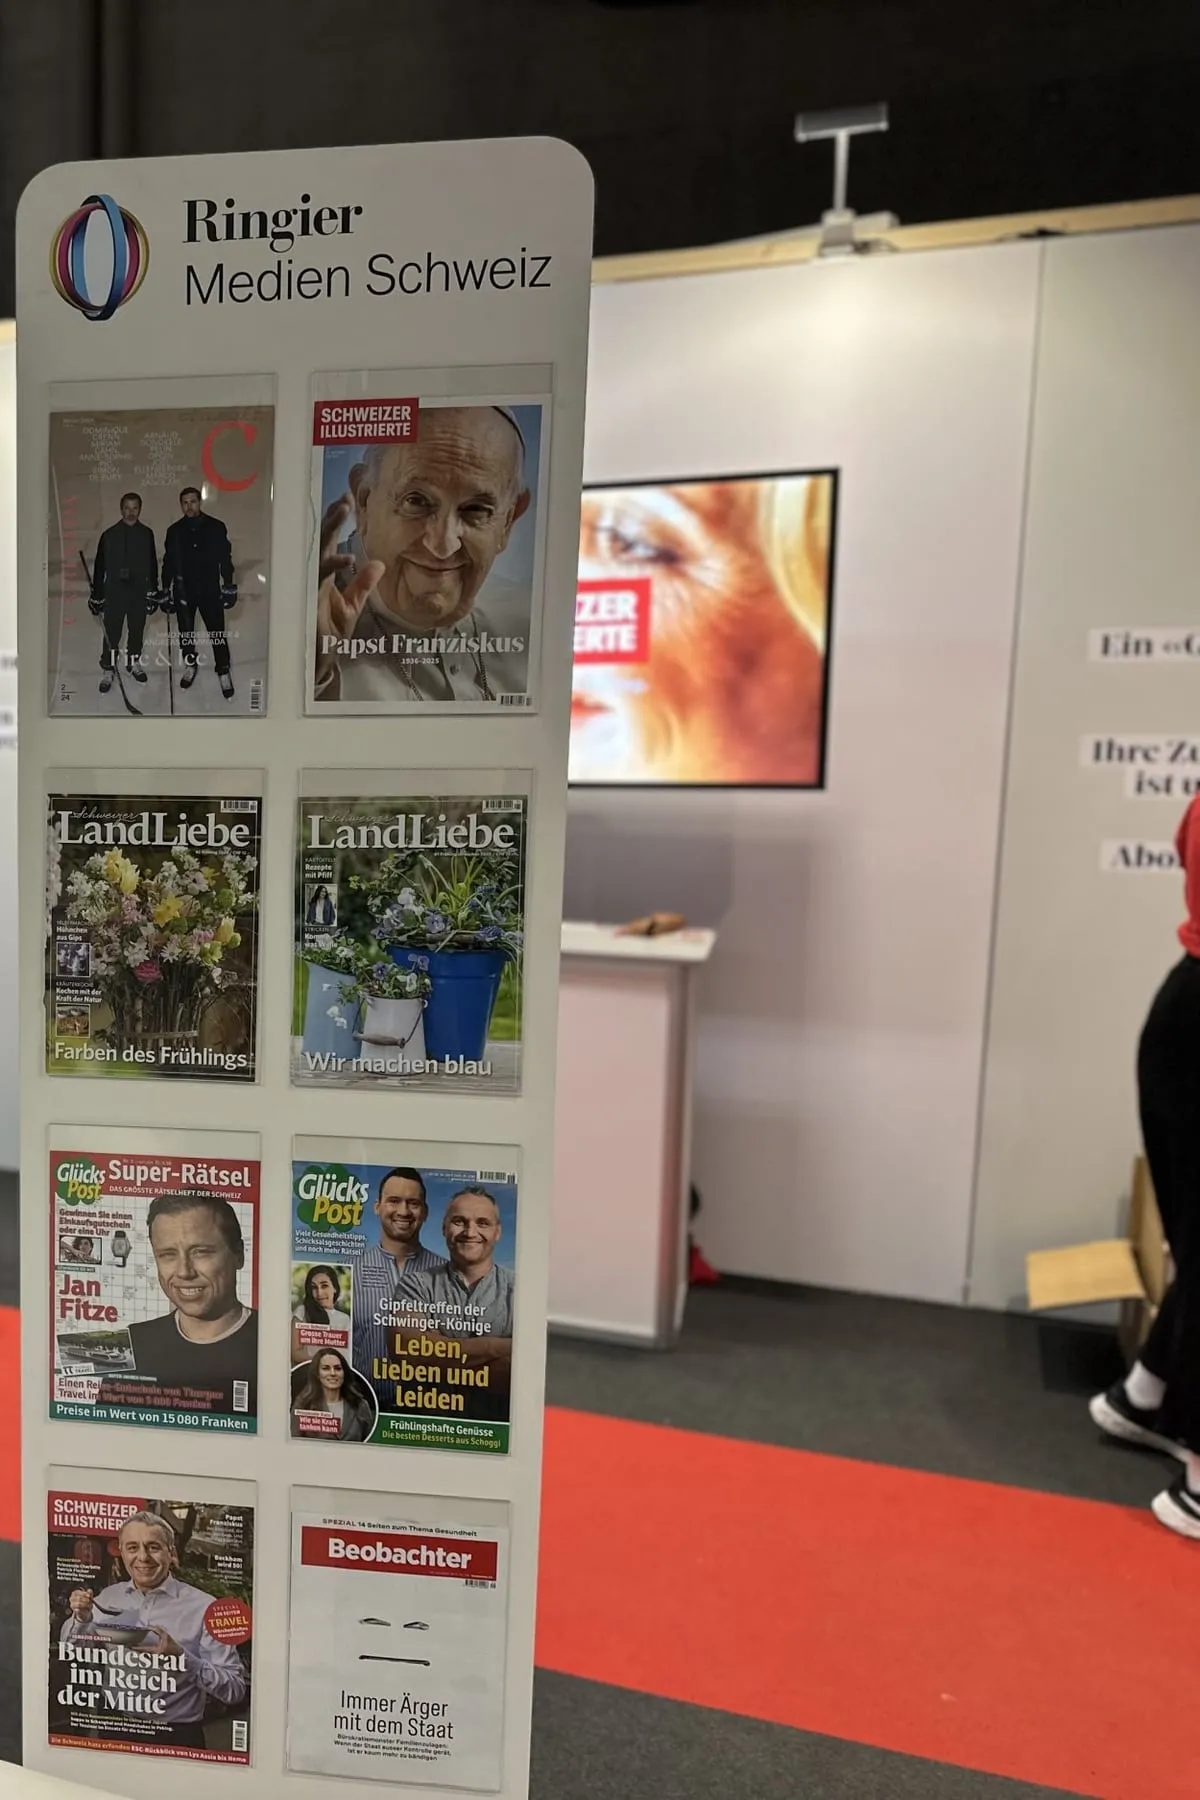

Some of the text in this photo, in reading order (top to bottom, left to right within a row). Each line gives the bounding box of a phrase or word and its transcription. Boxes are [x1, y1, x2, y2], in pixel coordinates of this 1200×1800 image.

[182, 193, 363, 254] Ringier
[186, 247, 552, 305] Medien Schweiz
[321, 406, 411, 422] SCHWEIZER
[320, 423, 410, 438] ILLUSTRIERTE
[202, 421, 258, 492] C
[321, 632, 524, 659] Papst Franziskus
[1101, 633, 1152, 656] Ein
[1092, 738, 1160, 763] Ihre
[56, 810, 250, 847] LandLiebe
[307, 813, 515, 849] LandLiebe
[1112, 844, 1177, 868] Abo
[54, 1042, 247, 1070] Farben des Frühlings
[304, 1051, 492, 1075] Wir machen blau
[57, 1159, 251, 1187] Glücks Super-Rätsel
[67, 1179, 102, 1200] Post
[123, 1186, 153, 1194] GRÖSSTE
[154, 1188, 196, 1197] RÄTSELHEFT
[211, 1191, 241, 1199] SCHWEIZ
[299, 1174, 370, 1203] Glücks
[59, 1209, 97, 1218] Gewinnen
[112, 1212, 133, 1220] einen
[59, 1217, 131, 1228] Einkaufsgutschein
[313, 1196, 363, 1225] Post
[96, 1228, 110, 1236] Uhr
[59, 1274, 100, 1296] Jan
[60, 1298, 118, 1322] Fitze
[379, 1298, 486, 1316] Gipfeltreffen der
[373, 1313, 492, 1335] Schwinger-Könige
[395, 1334, 468, 1363] Leben,
[59, 1378, 84, 1388] Einen
[373, 1358, 489, 1387] lieben und
[59, 1390, 87, 1400] Travel
[395, 1385, 464, 1411] leiden
[56, 1404, 90, 1417] Preise
[92, 1407, 107, 1418] im
[109, 1409, 135, 1420] Wert
[139, 1413, 160, 1422] von
[201, 1416, 248, 1429] Franken
[390, 1420, 493, 1437] Frühlingshafte Genüsse
[382, 1430, 395, 1438] Die
[395, 1431, 420, 1440] besten
[421, 1434, 454, 1443] Desserts
[54, 1499, 138, 1517] SCHWEIZER
[54, 1514, 127, 1530] ILLUSTRIER
[322, 1519, 356, 1527] SPEZIAL
[367, 1522, 391, 1530] Seiten
[409, 1525, 433, 1533] Thema
[434, 1528, 477, 1537] Gesundheit
[328, 1538, 472, 1569] Beobachter
[208, 1616, 249, 1628] TRAVEL
[57, 1641, 187, 1672] Bundesrat
[70, 1663, 176, 1693] im Reich
[57, 1685, 166, 1714] der Mitte
[341, 1690, 448, 1719] Immer Ärger
[334, 1714, 453, 1739] mit dem Staat
